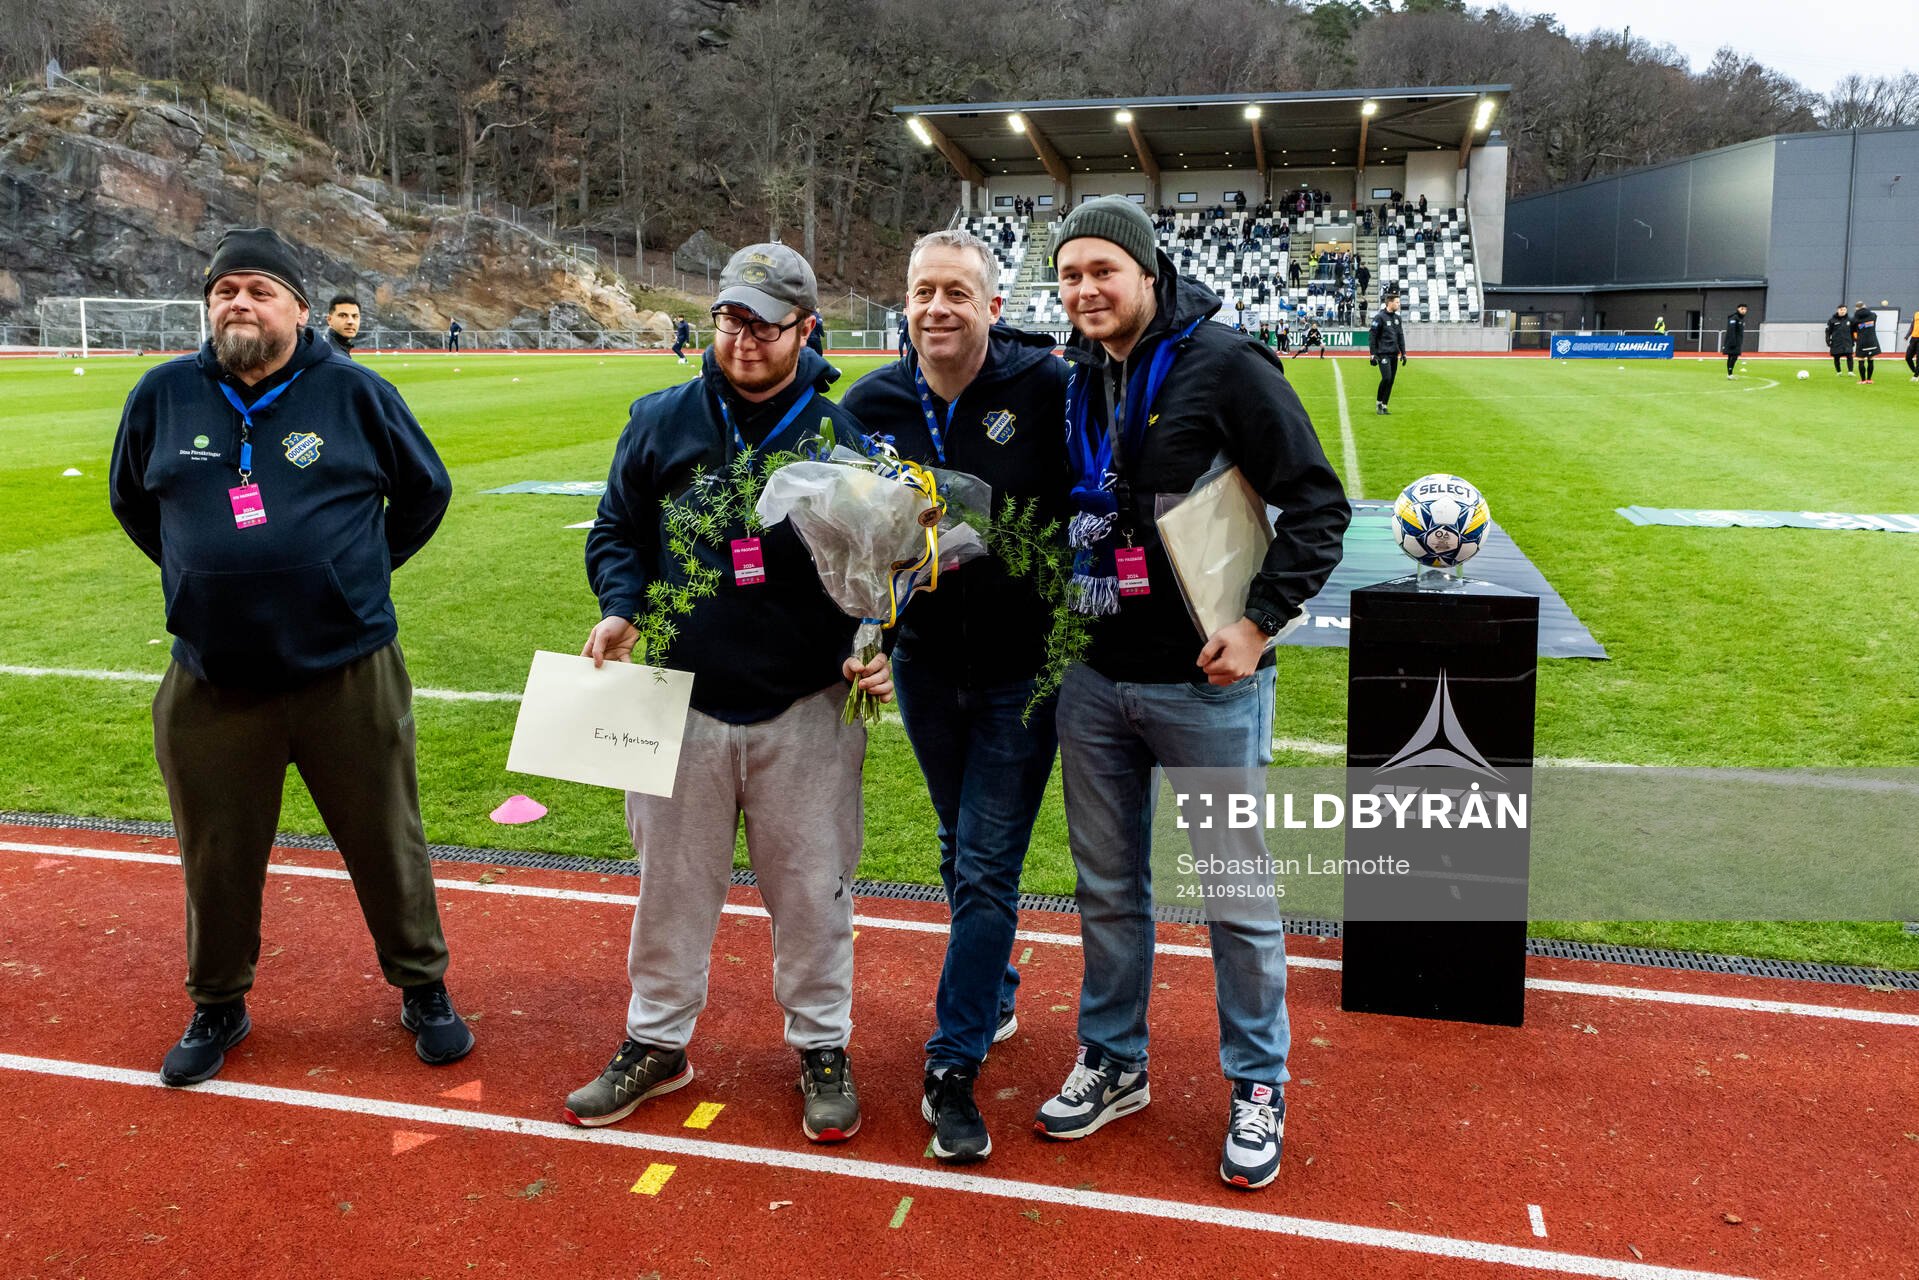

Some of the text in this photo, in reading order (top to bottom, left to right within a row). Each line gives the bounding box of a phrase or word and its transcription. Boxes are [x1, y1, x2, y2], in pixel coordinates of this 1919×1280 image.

[989, 413, 1010, 437] ODDEVOLD
[287, 436, 316, 459] ODDEVOLD
[298, 449, 315, 463] 1932
[1419, 483, 1471, 498] SELECT
[594, 727, 659, 754] Erik Karlsson
